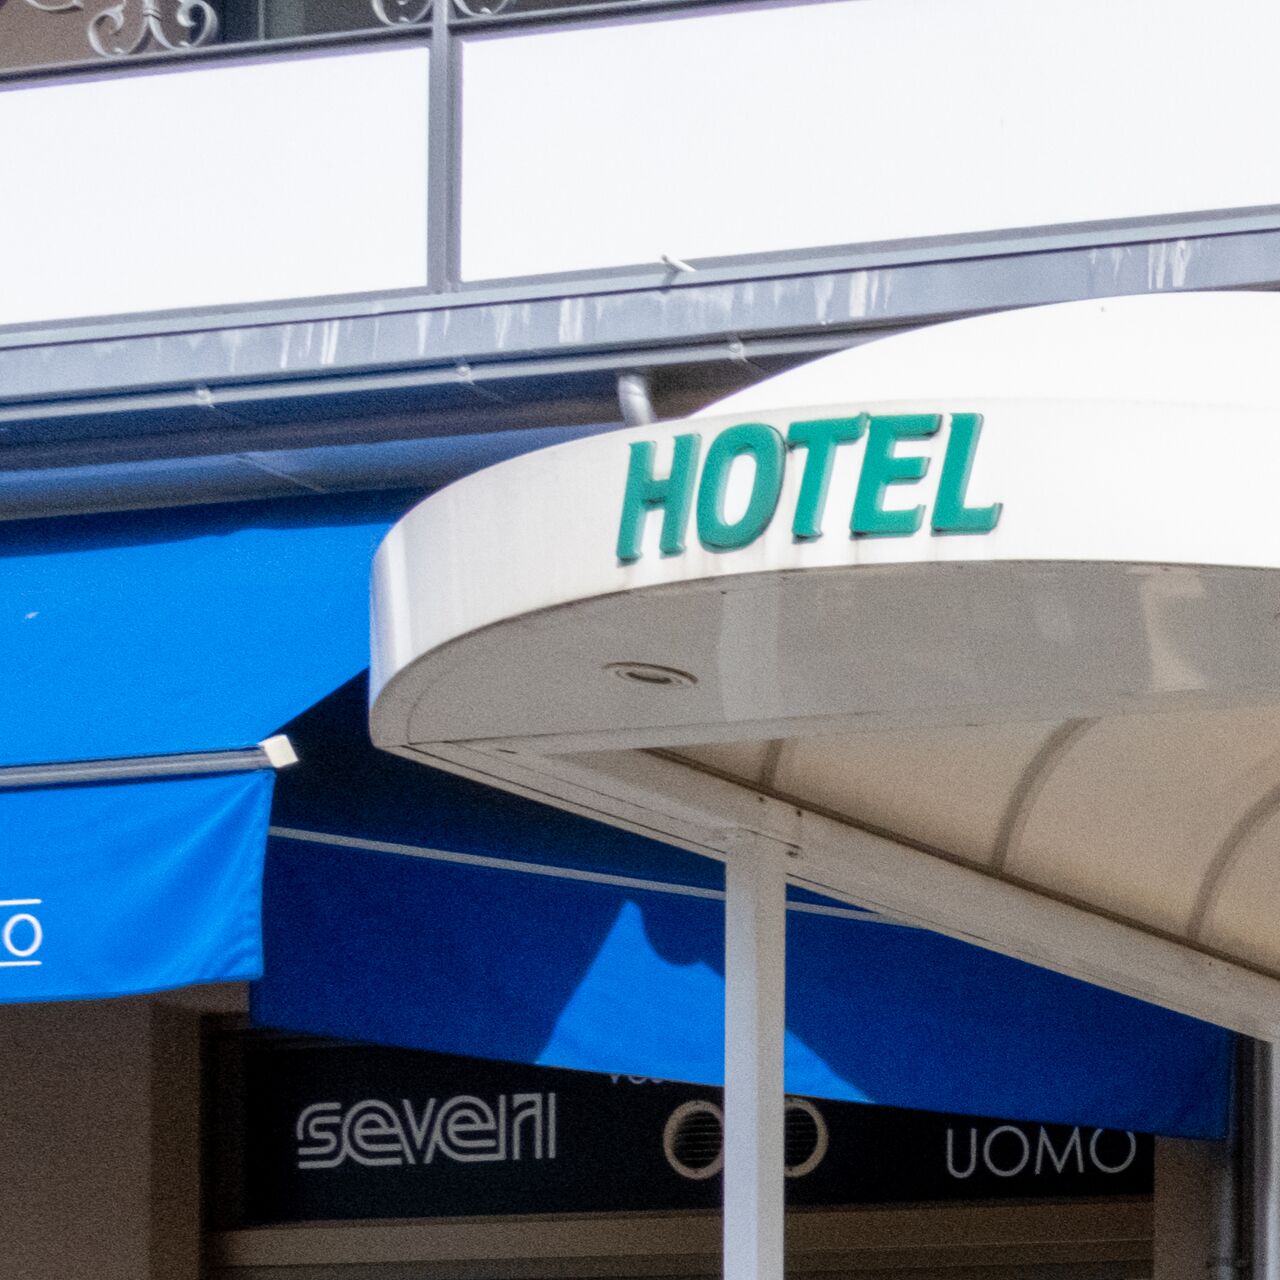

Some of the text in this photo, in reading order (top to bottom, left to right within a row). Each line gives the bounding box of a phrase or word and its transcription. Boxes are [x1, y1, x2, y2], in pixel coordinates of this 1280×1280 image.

[615, 411, 1004, 565] HOTEL
[296, 1092, 557, 1170] seven
[946, 1125, 1137, 1179] UOMO
